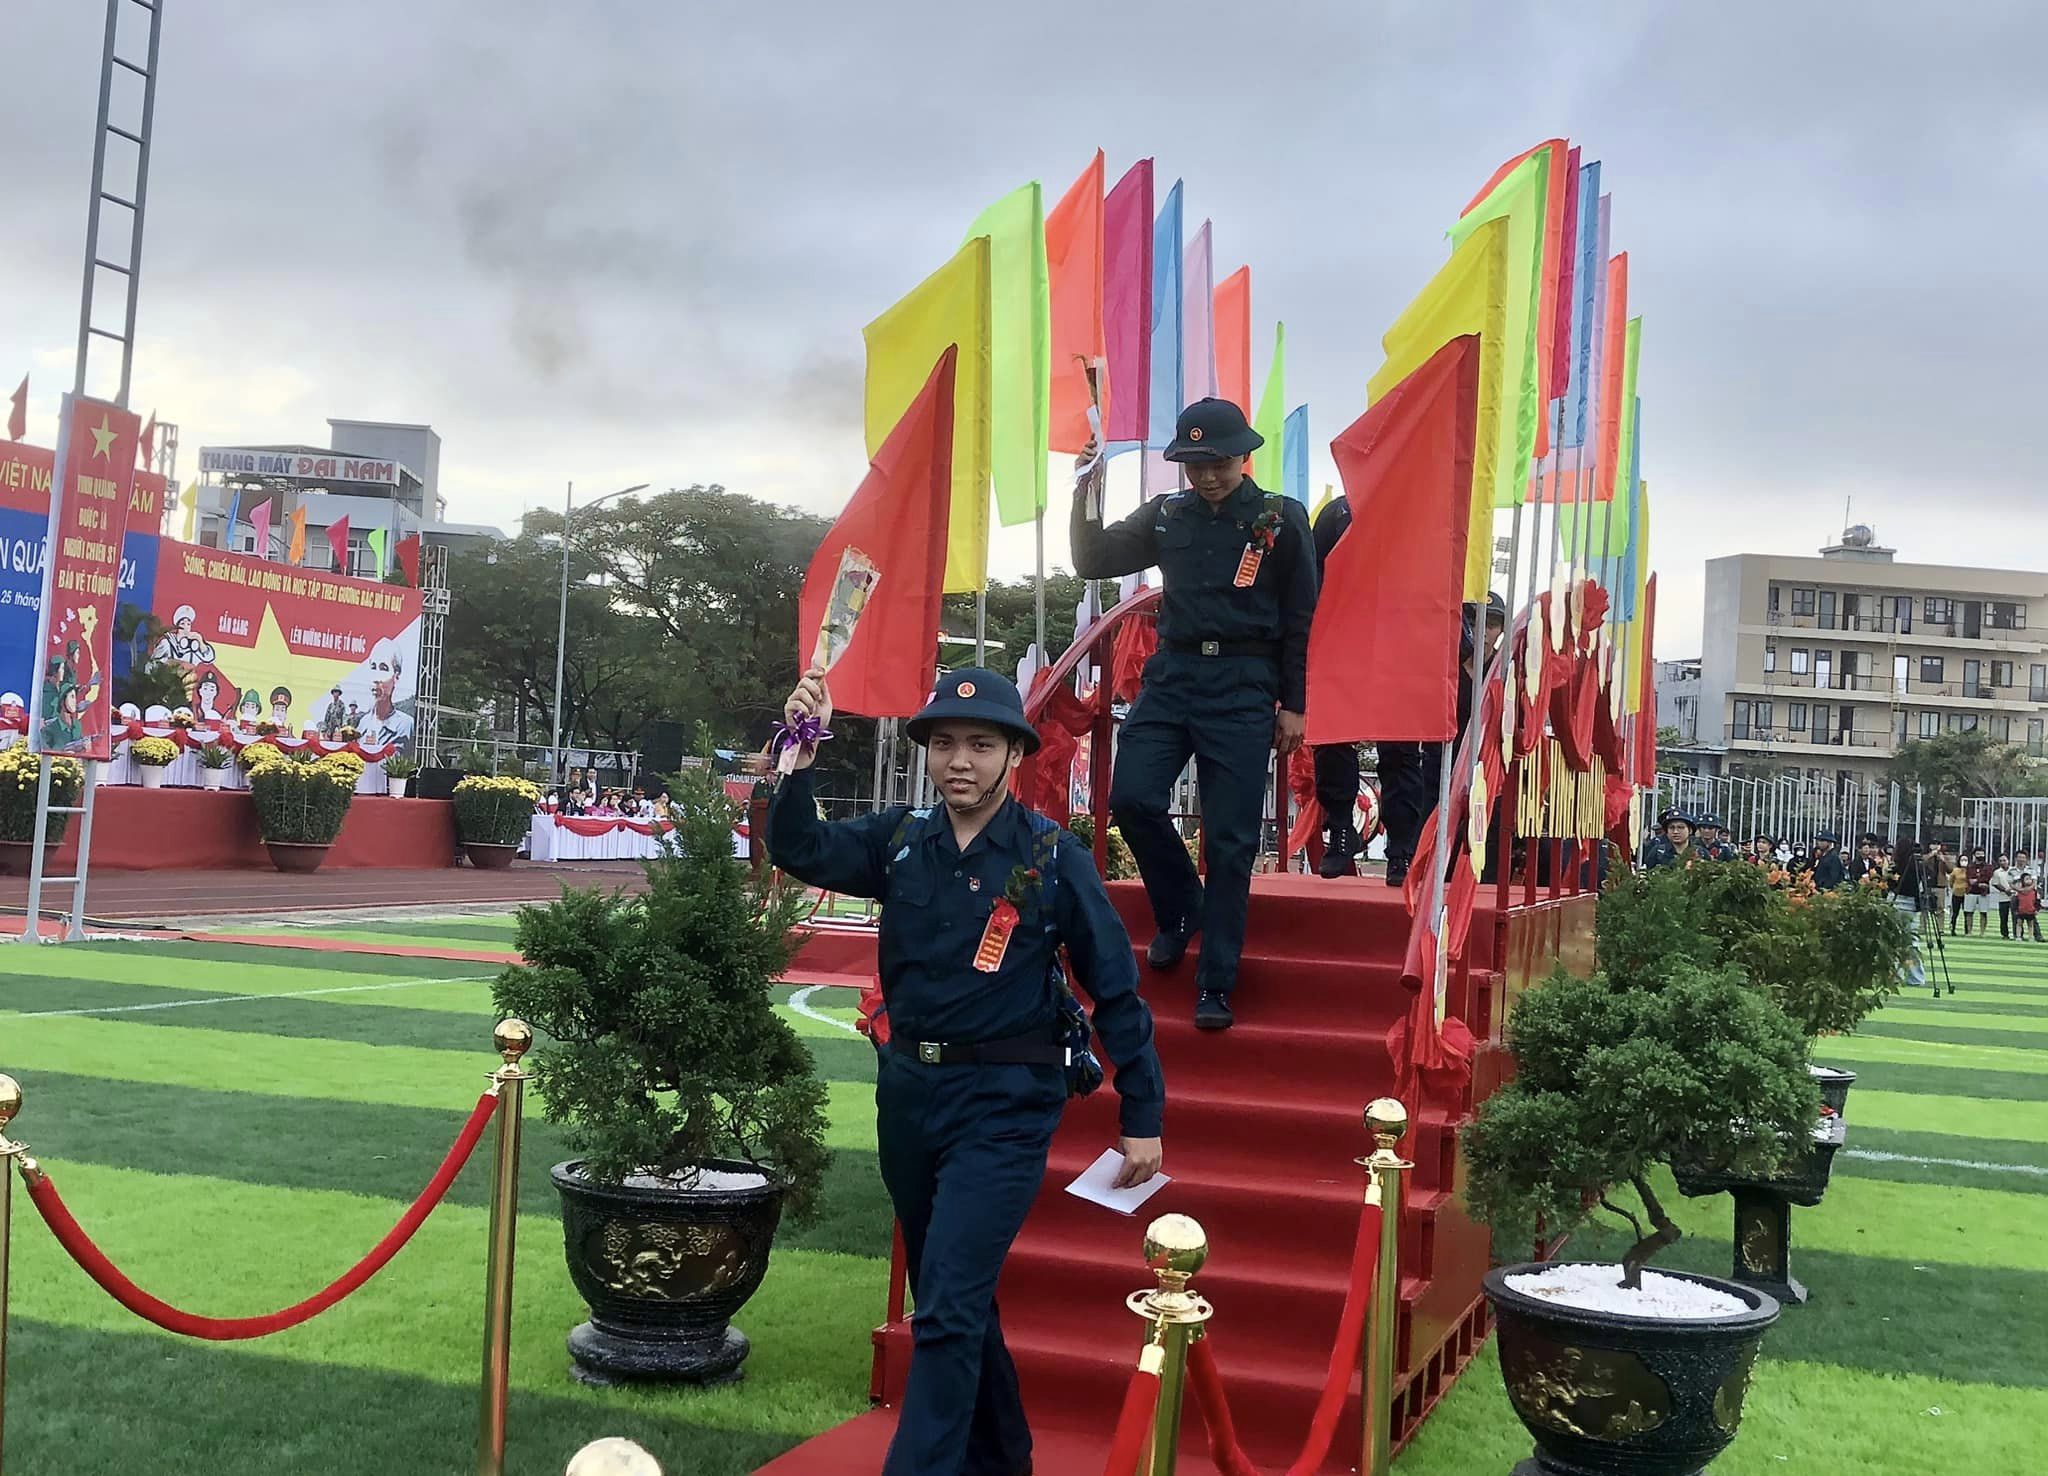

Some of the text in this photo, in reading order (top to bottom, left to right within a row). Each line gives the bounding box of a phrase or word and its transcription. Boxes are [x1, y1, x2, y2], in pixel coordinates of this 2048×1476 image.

[31, 466, 52, 493] NA
[201, 452, 255, 471] THANG
[259, 454, 293, 474] MÁY
[344, 459, 393, 481] NAM
[13, 535, 48, 575] QUÂ
[247, 568, 261, 588] LAO
